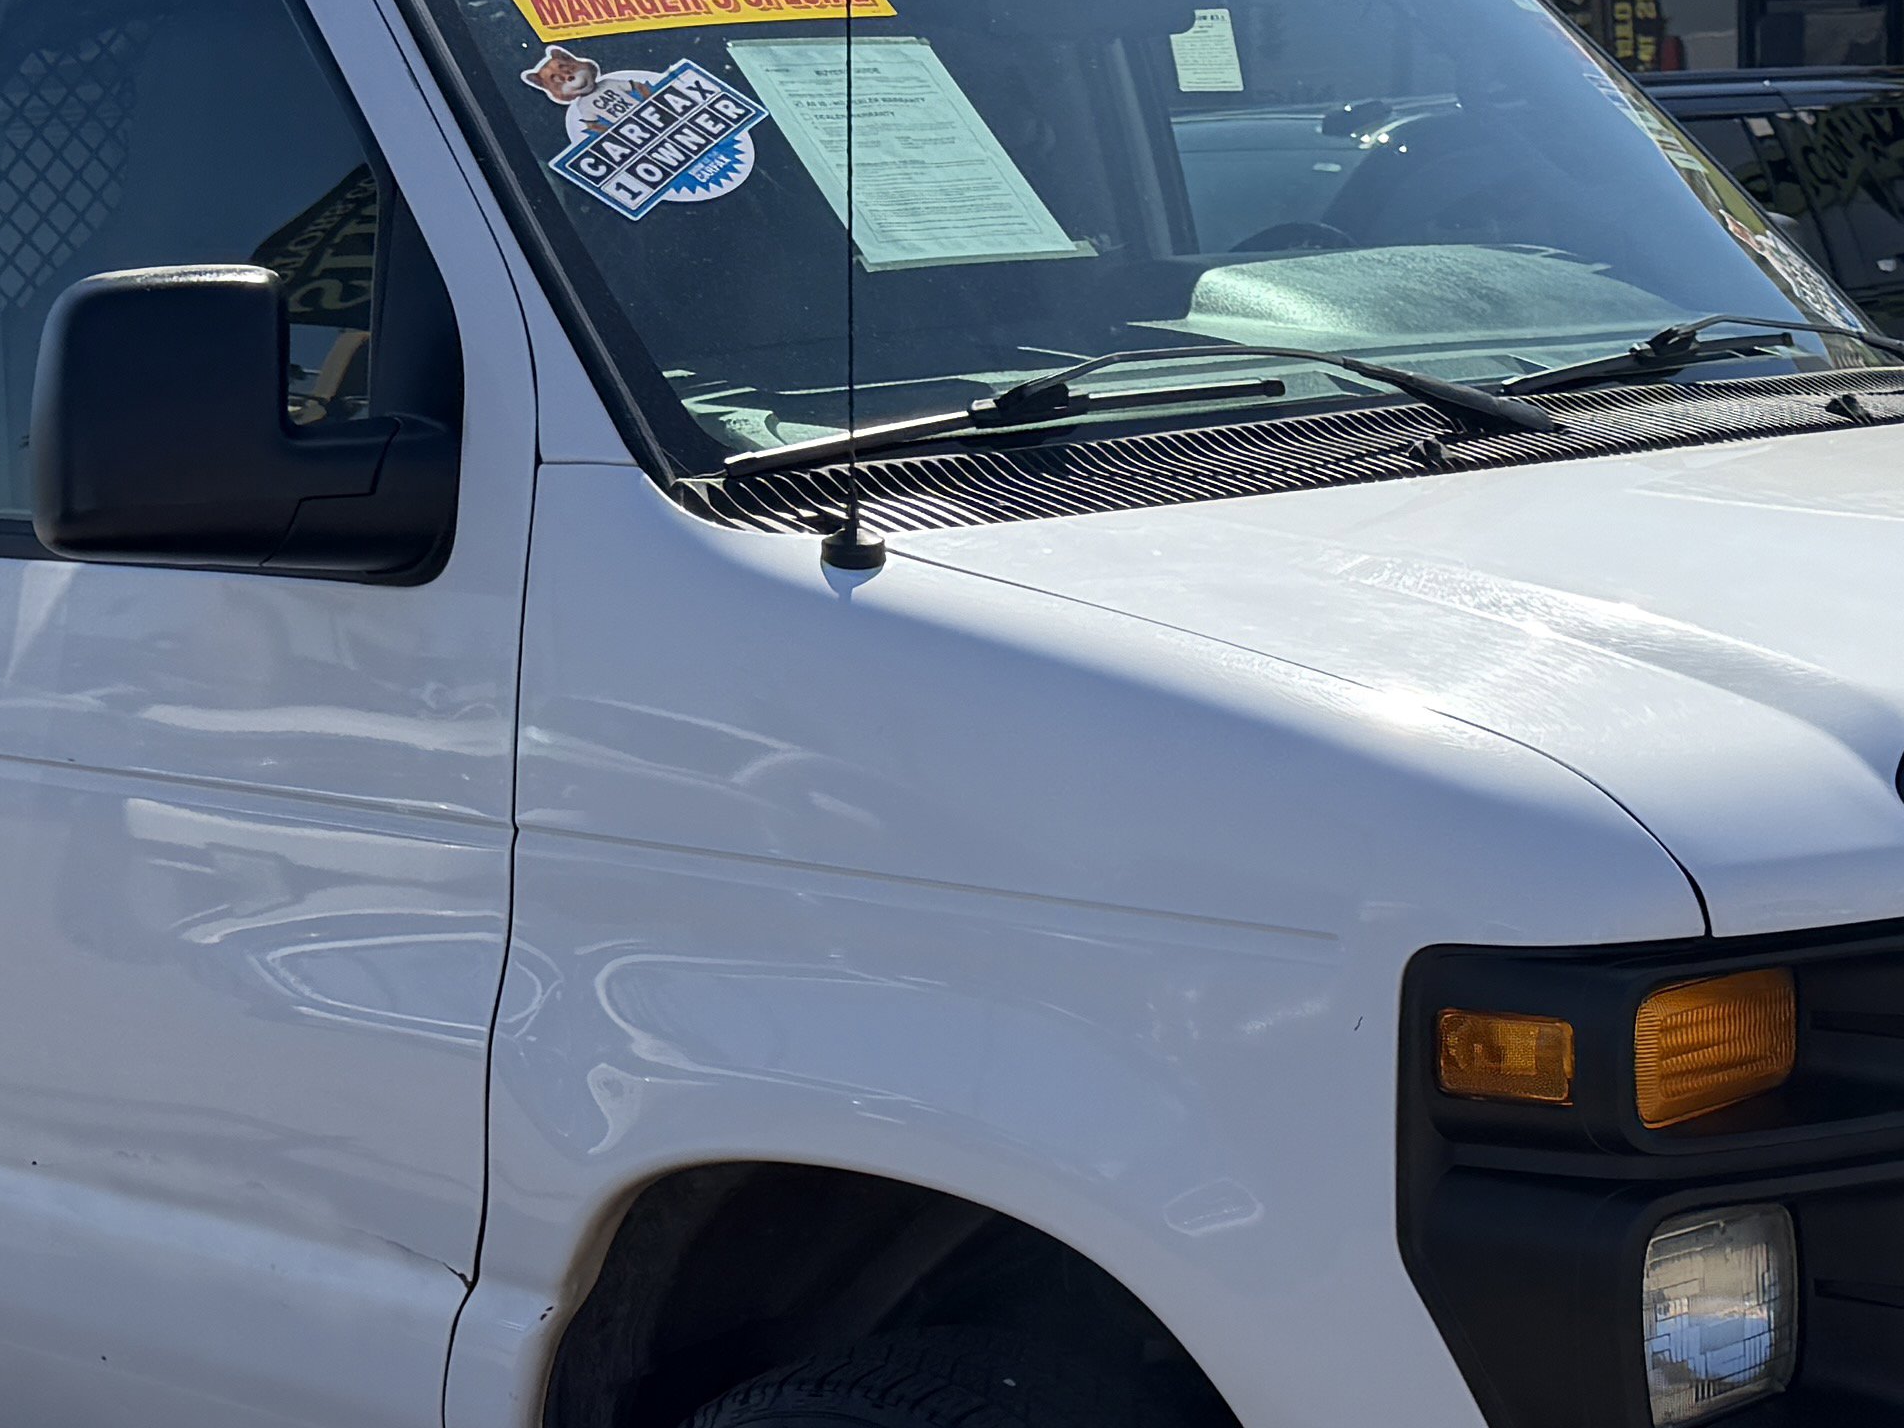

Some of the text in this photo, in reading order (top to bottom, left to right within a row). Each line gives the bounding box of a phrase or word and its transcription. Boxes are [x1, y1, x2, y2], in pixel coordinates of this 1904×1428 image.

[579, 79, 716, 177] CARFAX
[592, 88, 621, 110] CAR
[605, 96, 634, 119] FOX
[614, 98, 746, 202] 1 OWNER
